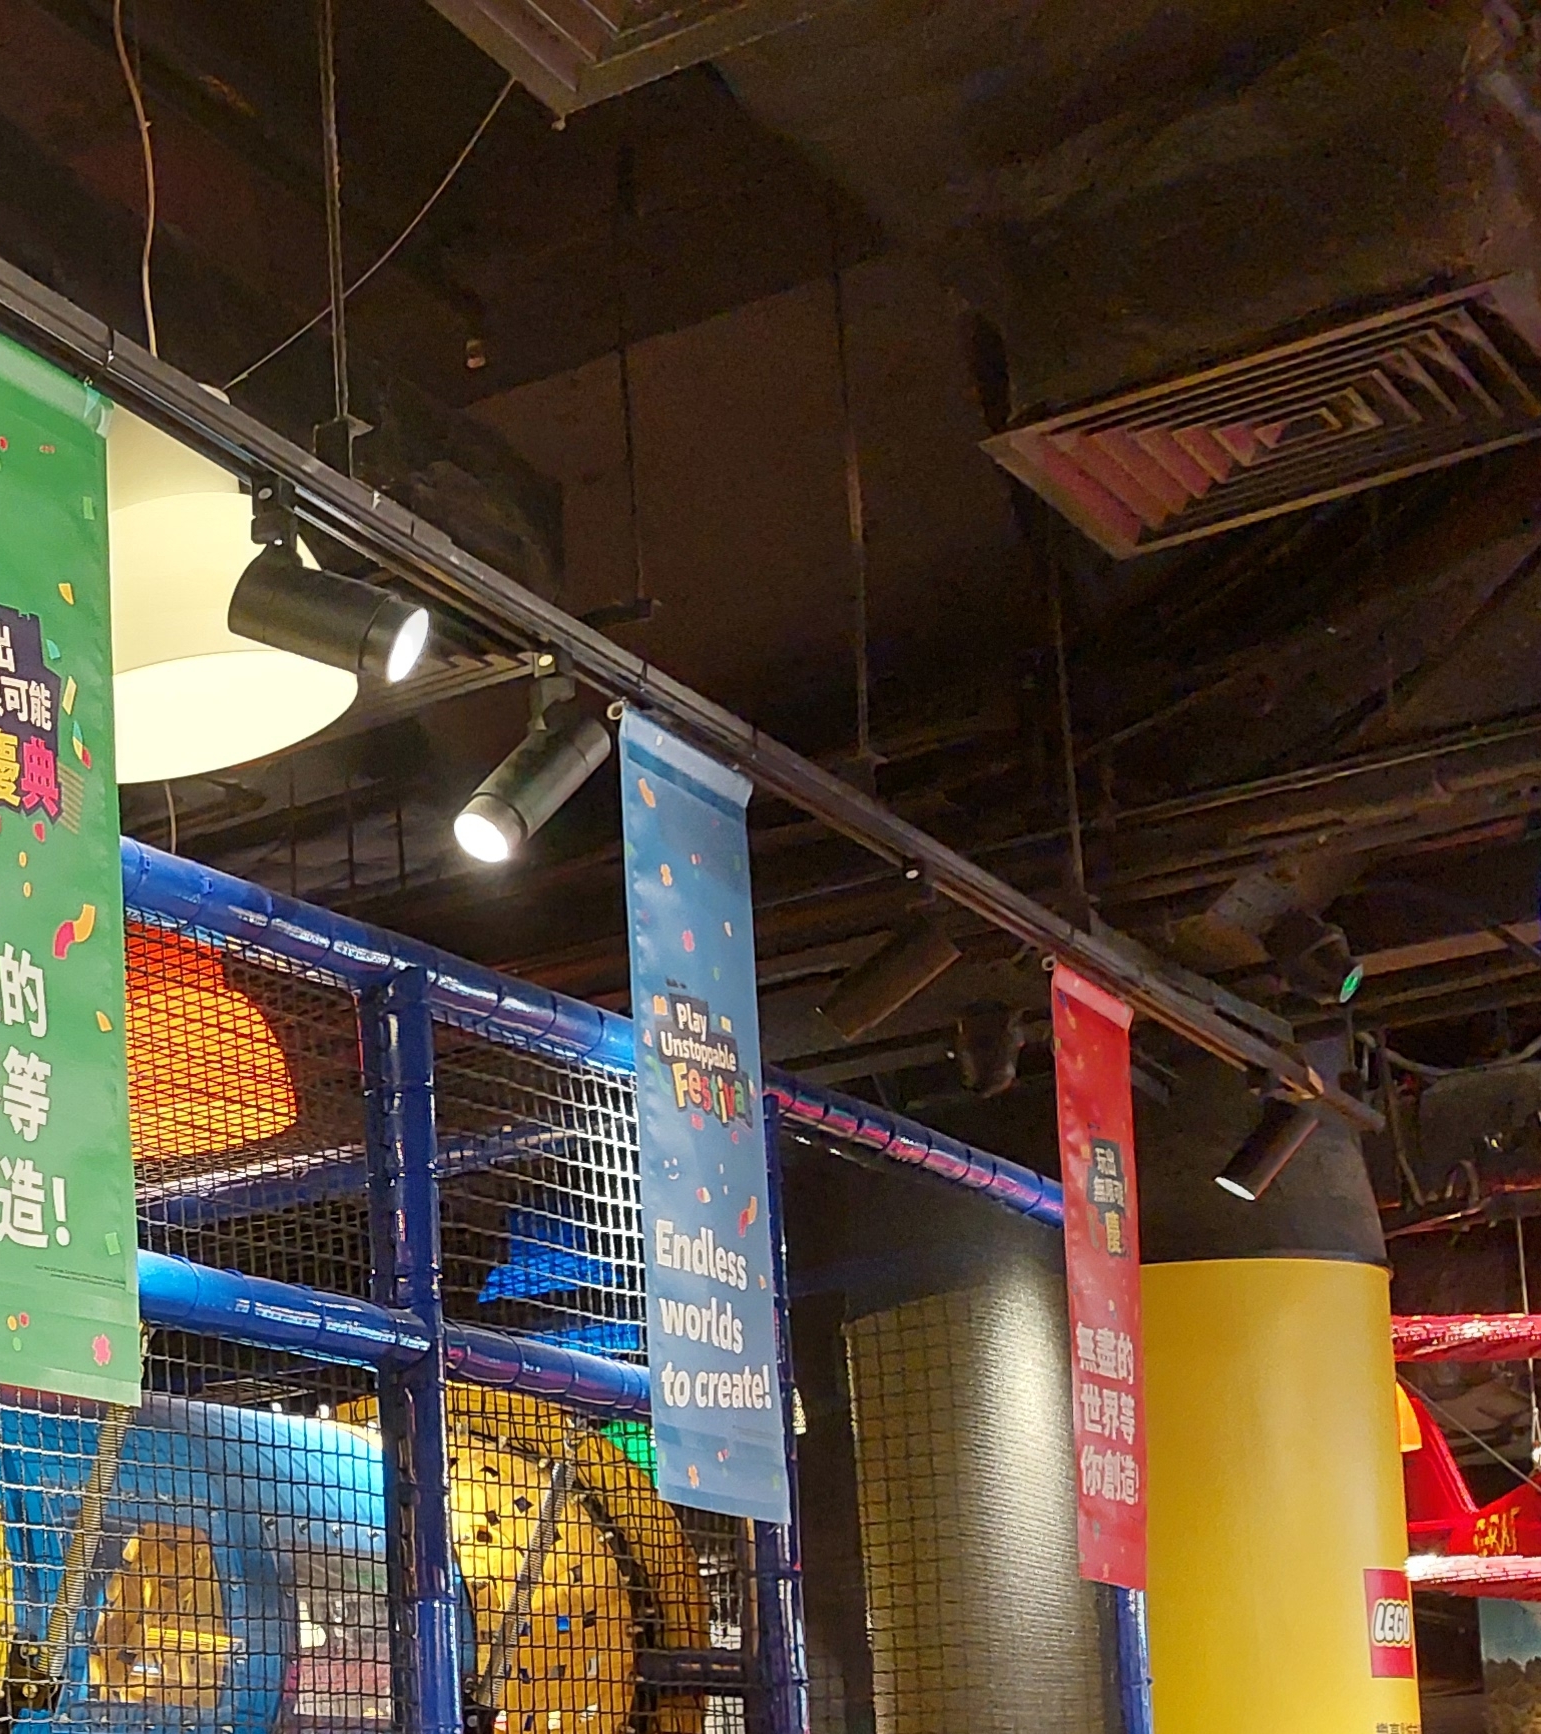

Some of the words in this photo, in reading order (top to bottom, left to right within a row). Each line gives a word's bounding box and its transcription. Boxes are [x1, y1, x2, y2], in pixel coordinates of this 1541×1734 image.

[675, 1002, 707, 1041] Play
[659, 1030, 737, 1072] Unstoppable
[656, 1218, 749, 1291] Endless
[658, 1296, 744, 1355] worlds
[660, 1361, 690, 1408] to
[694, 1364, 773, 1410] create!
[1373, 1602, 1410, 1644] LEGO
